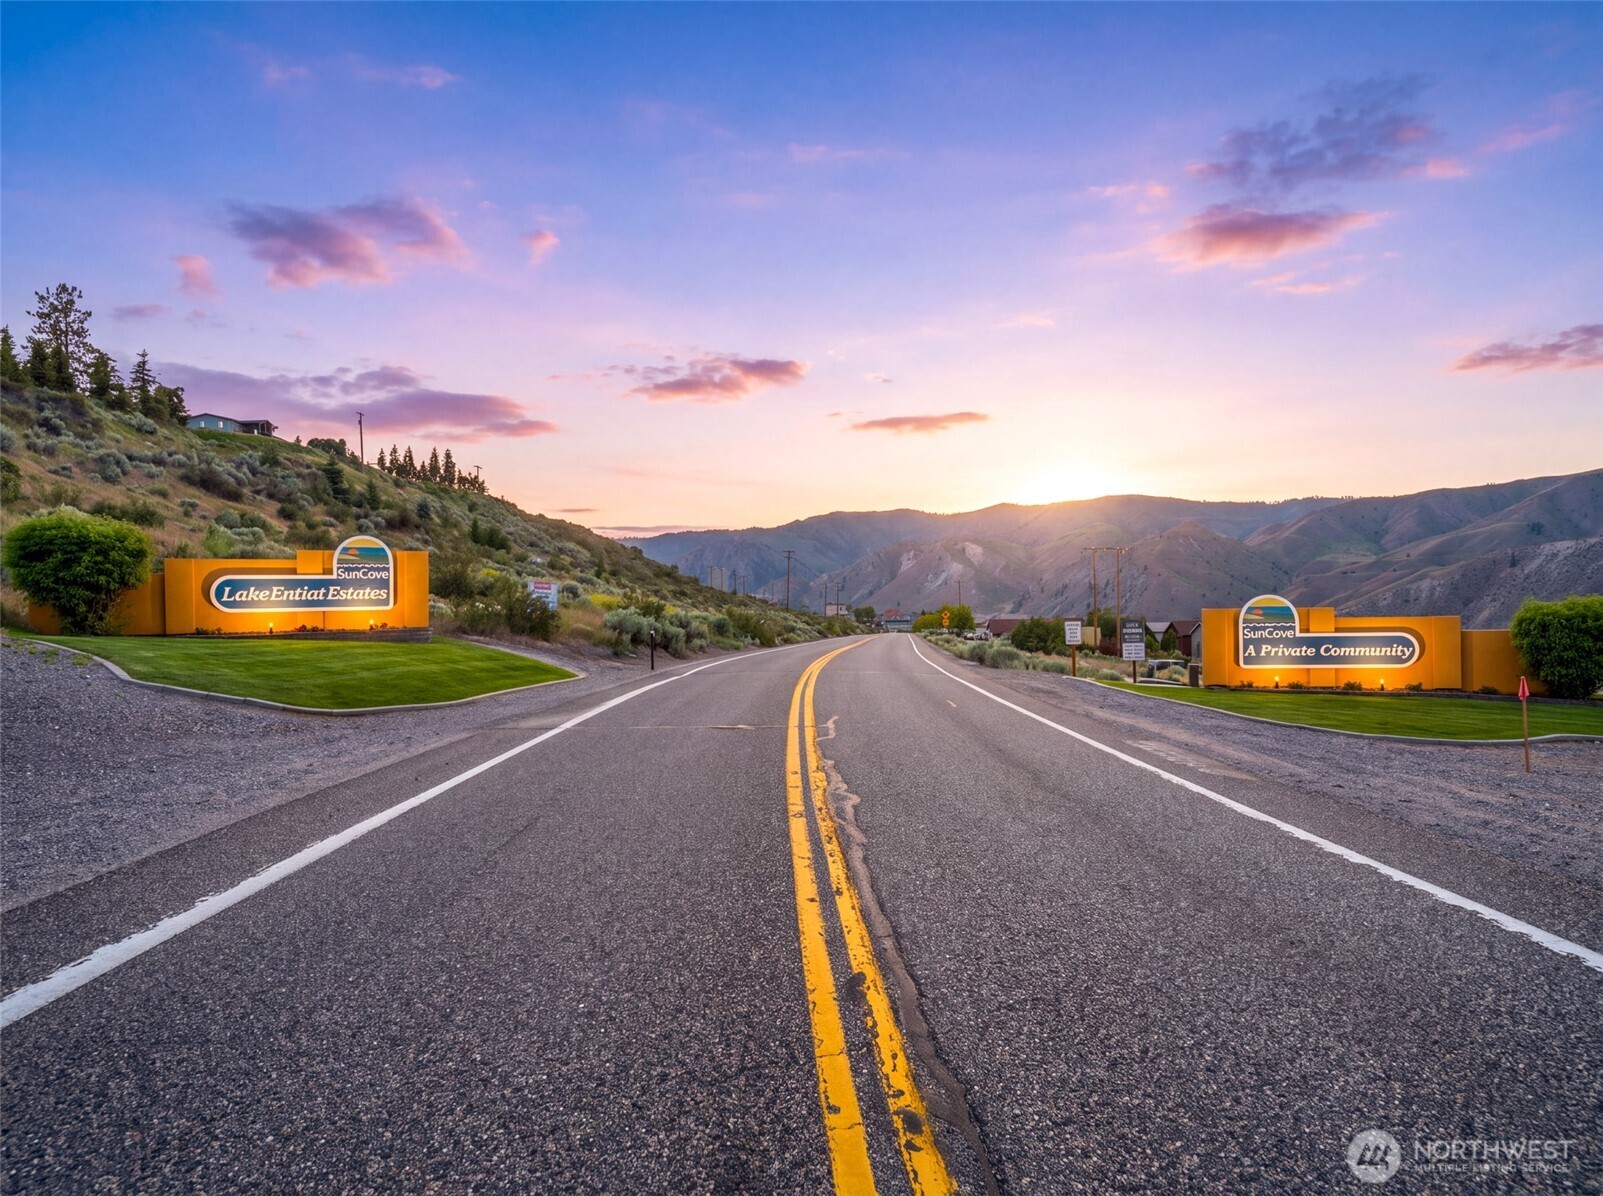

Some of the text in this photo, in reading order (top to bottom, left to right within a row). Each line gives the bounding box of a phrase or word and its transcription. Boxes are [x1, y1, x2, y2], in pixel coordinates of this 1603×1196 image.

[338, 568, 389, 580] SunCove
[221, 585, 388, 602] Lake Entiat Estates
[1243, 628, 1294, 638] SunCove
[1244, 644, 1413, 658] A Private Community
